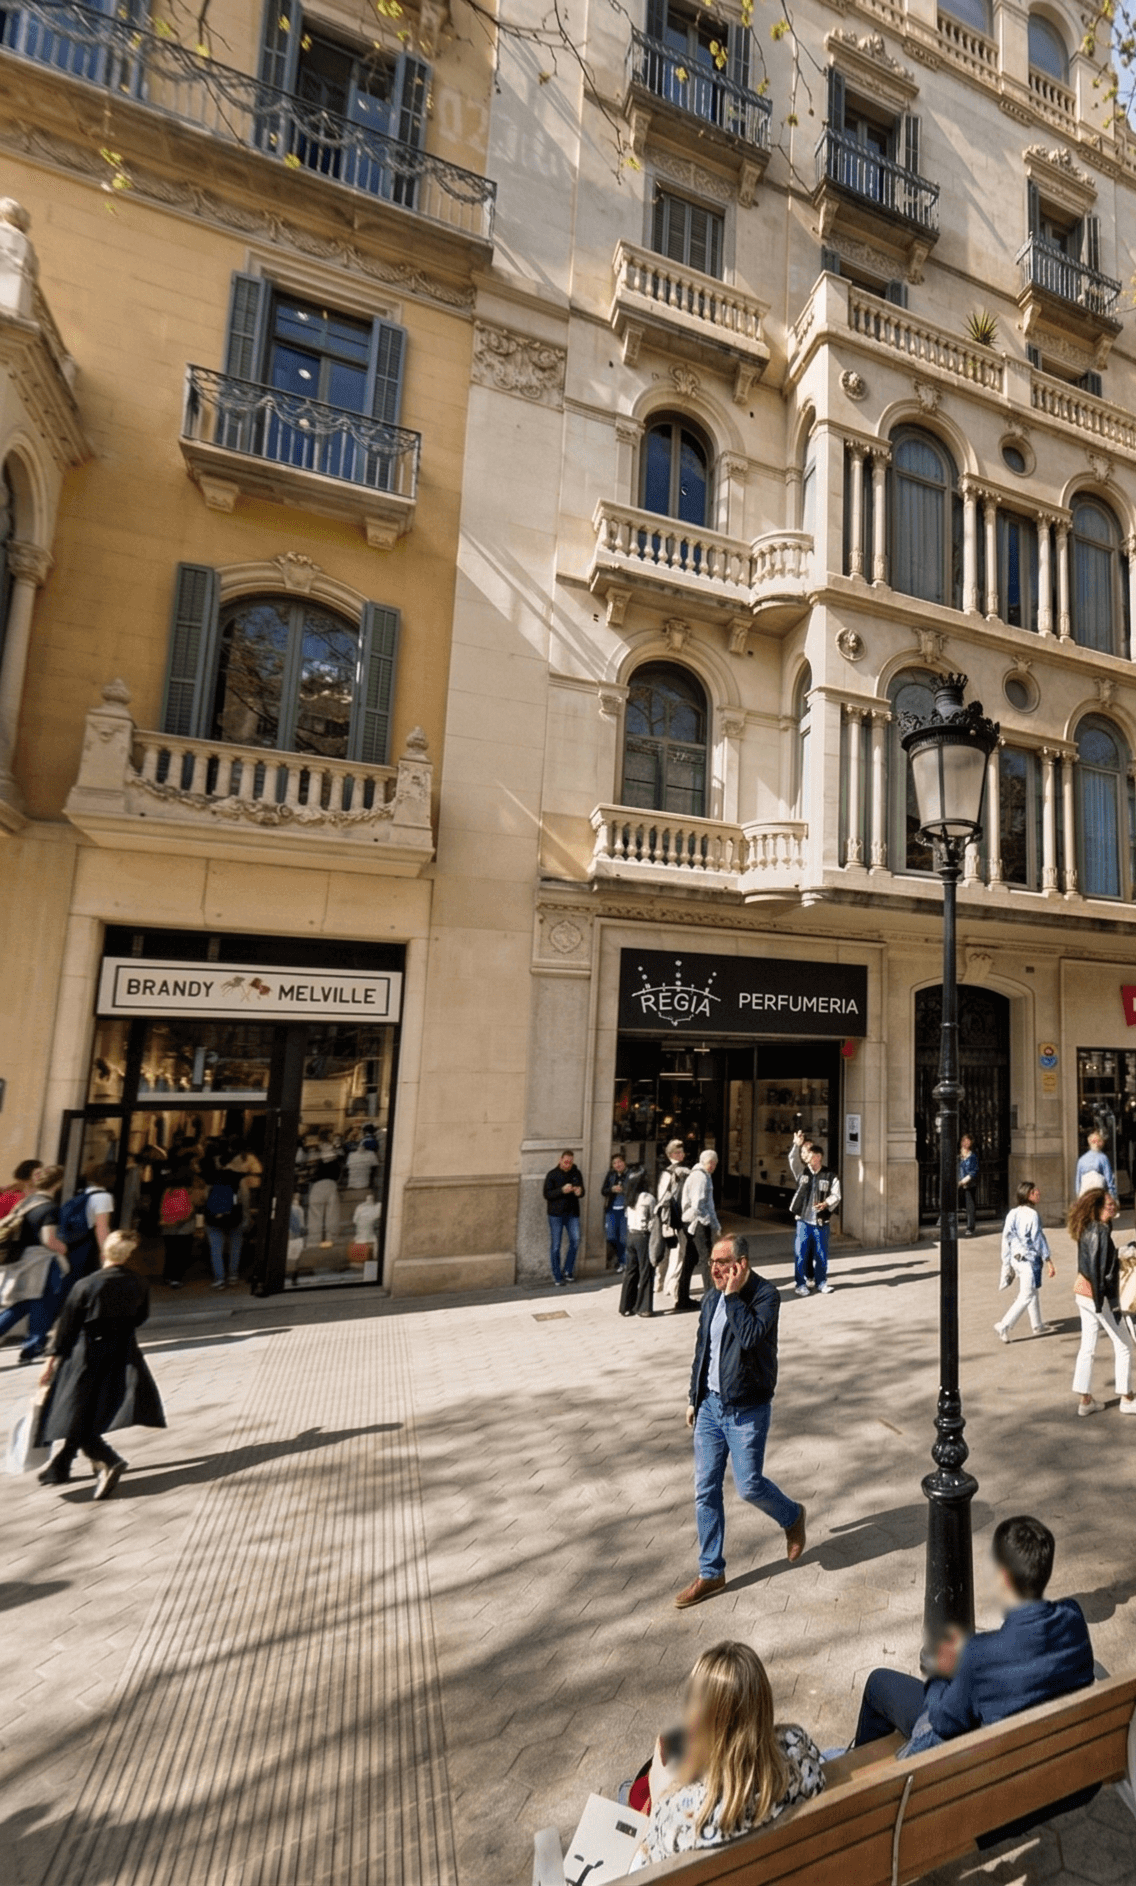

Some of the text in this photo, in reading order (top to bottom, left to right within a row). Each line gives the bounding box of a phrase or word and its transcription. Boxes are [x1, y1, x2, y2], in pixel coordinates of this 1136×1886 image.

[126, 978, 377, 1004] BRANDY MELVILLE
[738, 992, 859, 1015] PERFUMERIA
[640, 992, 711, 1017] REGIA
